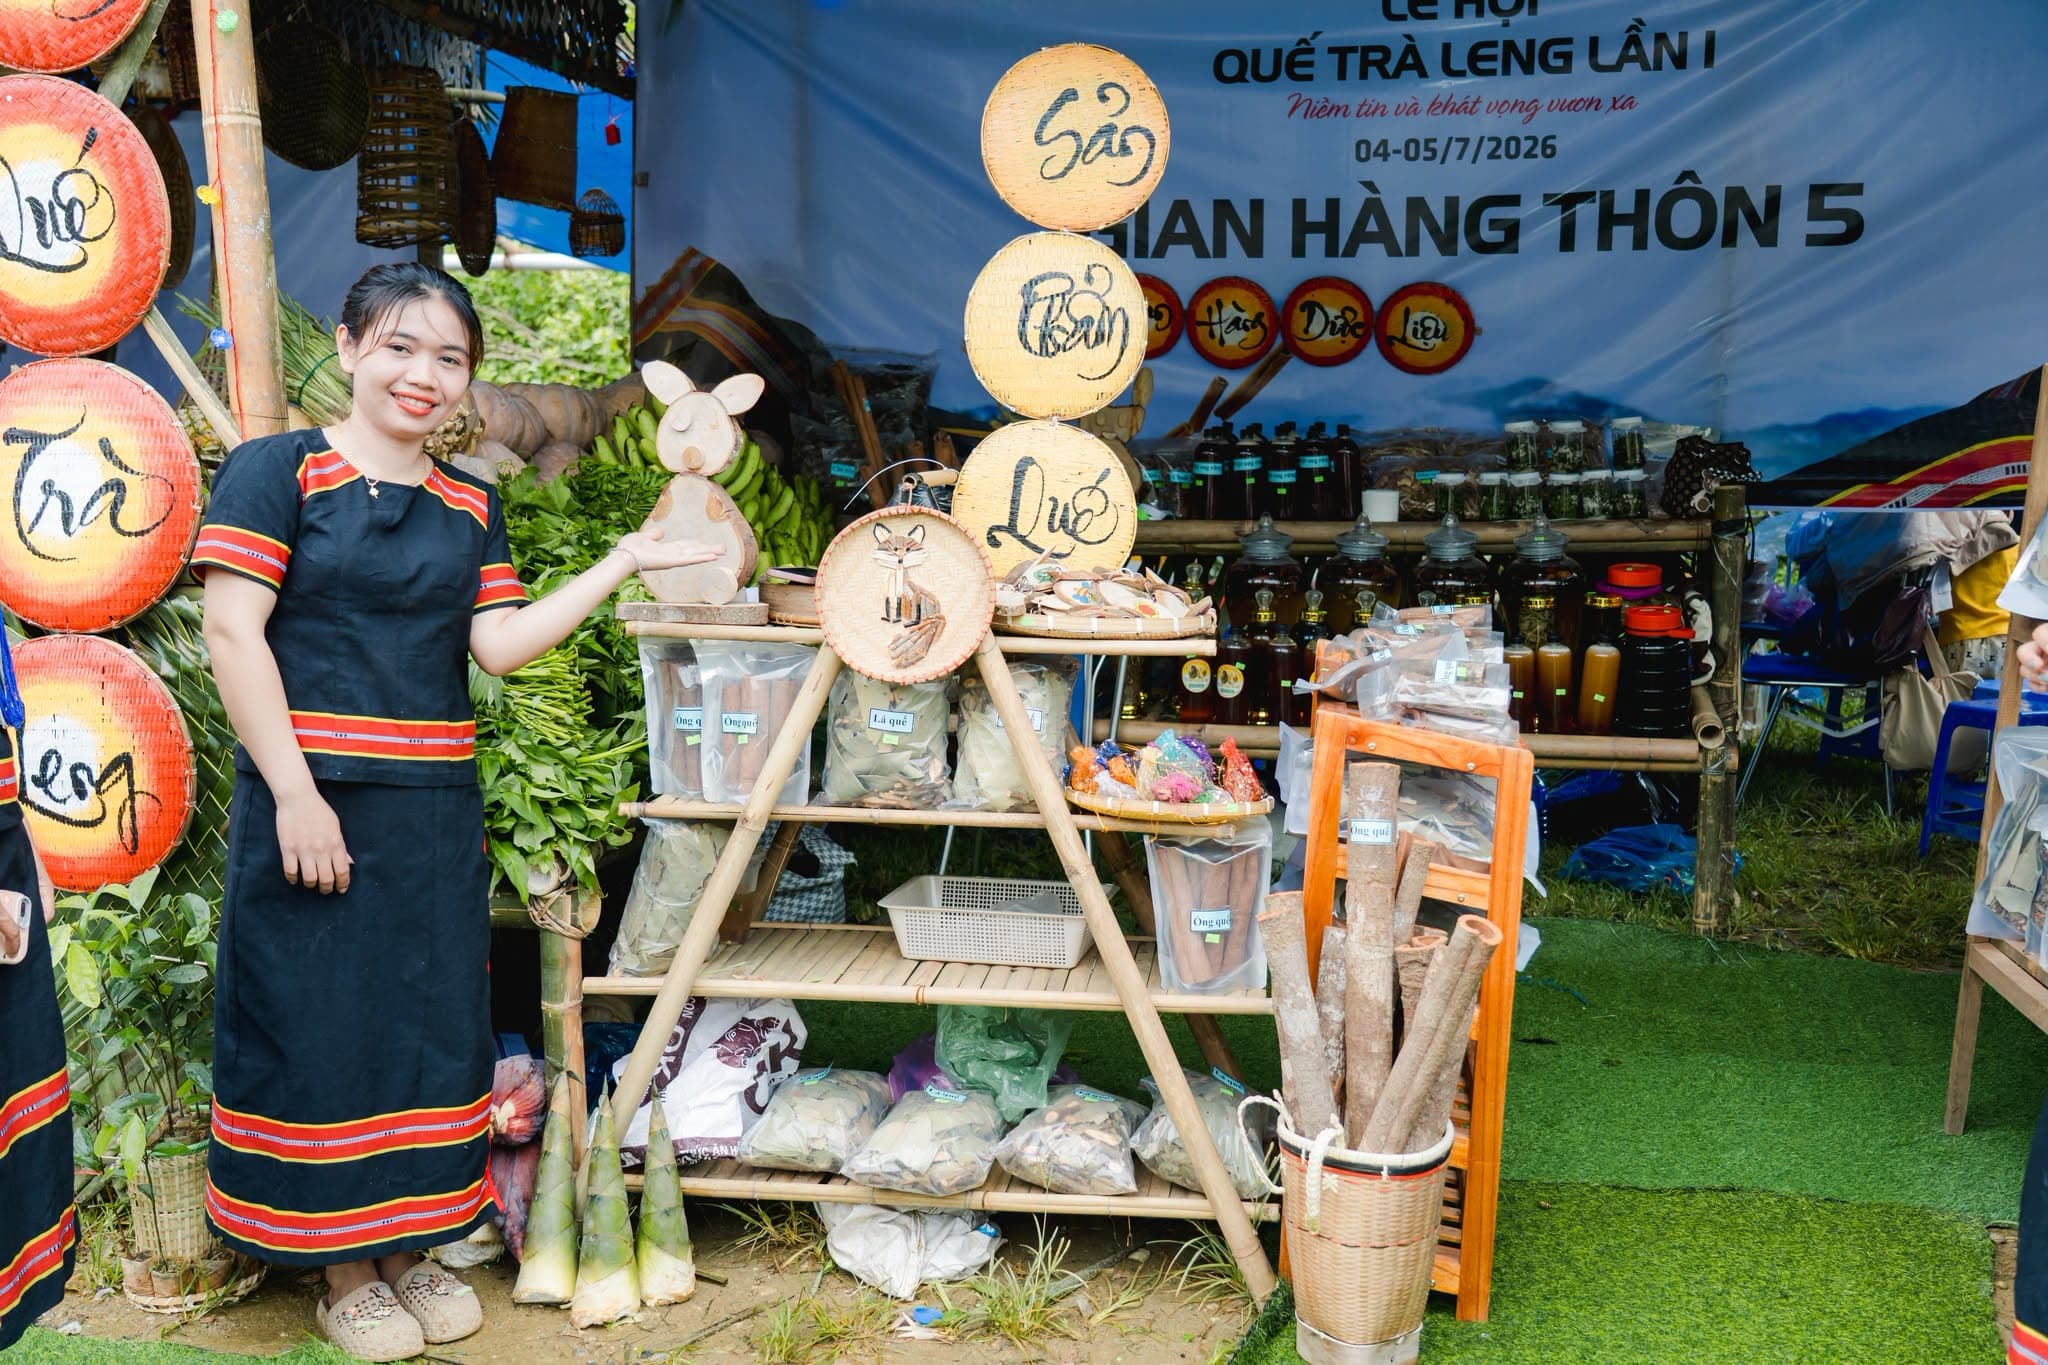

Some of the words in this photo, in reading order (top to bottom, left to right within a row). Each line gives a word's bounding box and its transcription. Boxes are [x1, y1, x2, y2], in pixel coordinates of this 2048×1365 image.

[1213, 31, 1323, 84] QUẾ
[1327, 34, 1429, 81] TRÀ
[1441, 37, 1574, 78] LENG
[1588, 17, 1689, 73] LẦN
[1704, 30, 1716, 69] I
[1355, 97, 1388, 118] tin
[1394, 96, 1421, 117] và
[1426, 92, 1481, 116] khát
[1486, 97, 1544, 125] vọng
[1605, 94, 1639, 115] xa
[1355, 135, 1557, 164] 04-05/7/2026
[1291, 181, 1521, 258] HÀNG
[1542, 170, 1782, 252] THÔN
[1805, 183, 1864, 248] 5
[3, 404, 176, 562] Trà
